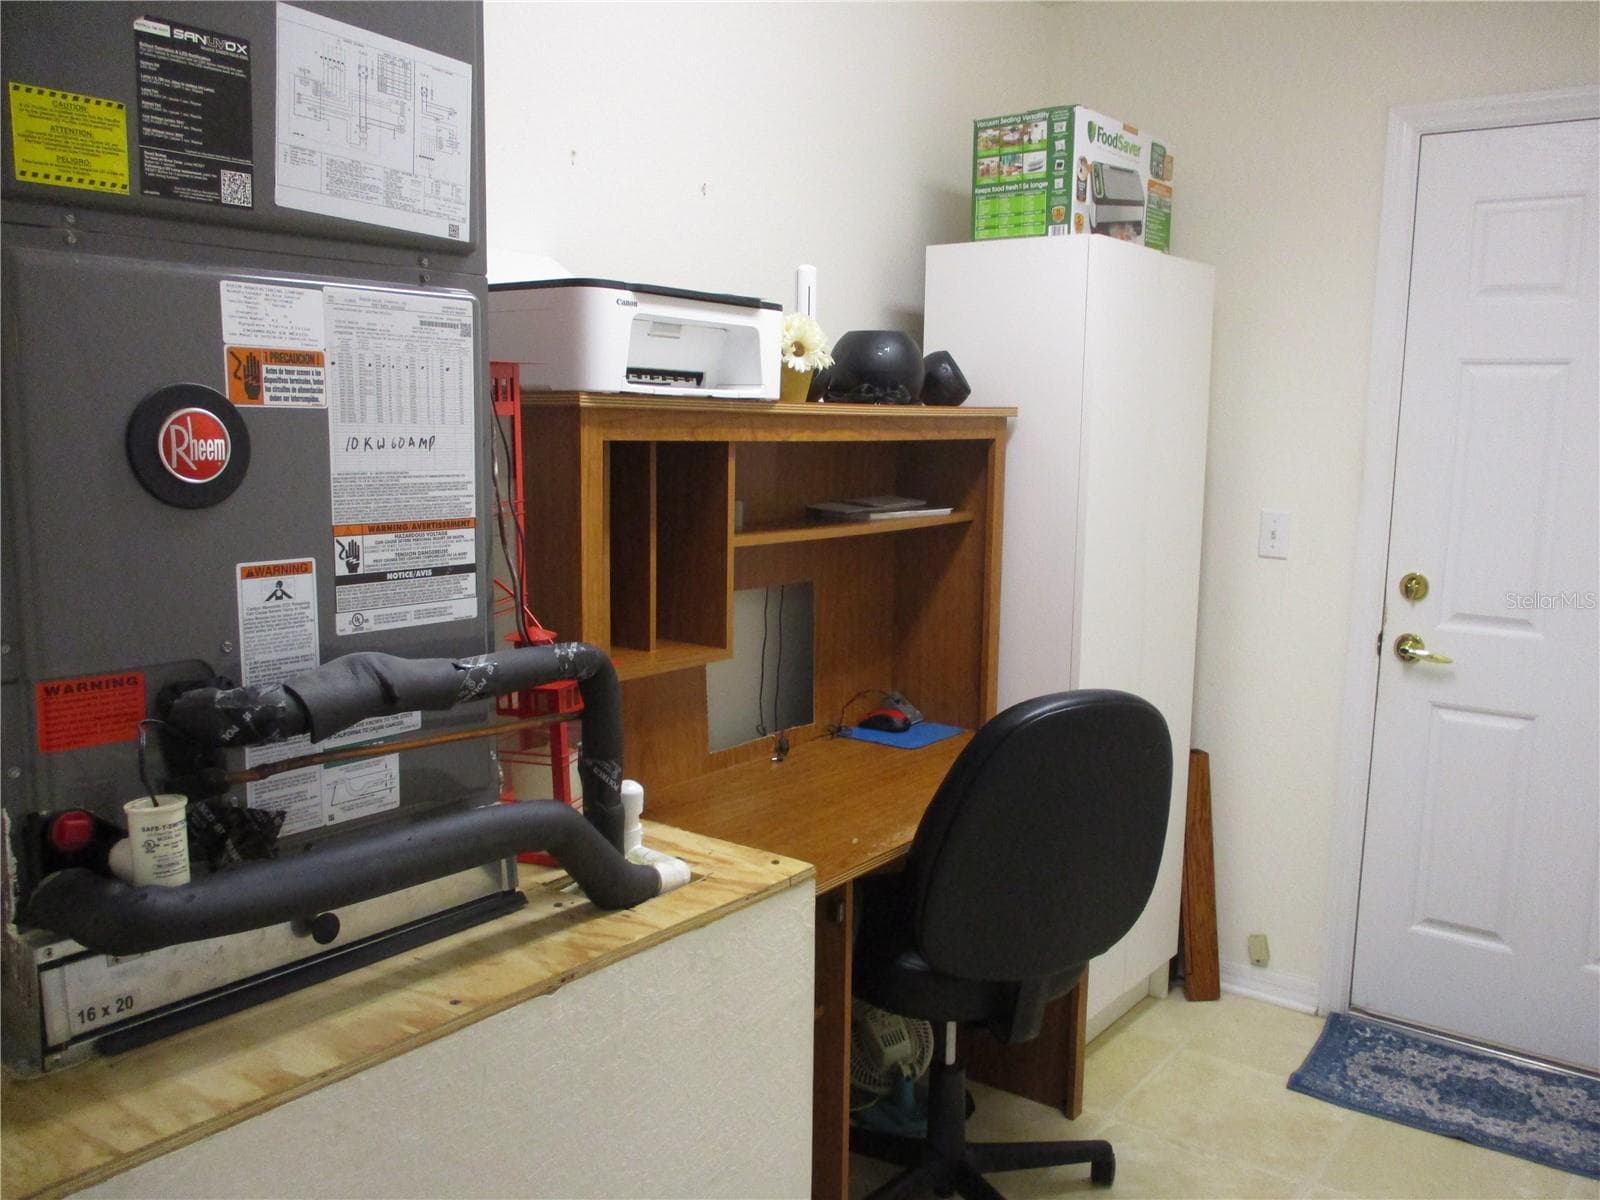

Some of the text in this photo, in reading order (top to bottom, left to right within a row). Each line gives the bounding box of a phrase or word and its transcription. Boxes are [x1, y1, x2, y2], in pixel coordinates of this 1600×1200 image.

[173, 27, 248, 55] SANUVOX
[1097, 126, 1142, 158] FoodSaver
[616, 298, 638, 307] Canon
[169, 415, 226, 471] Rheem
[255, 562, 309, 577] WARNING
[386, 569, 433, 580] NOTICE/AVIS
[44, 676, 138, 697] WARNING
[78, 995, 134, 1024] 16 x 20
